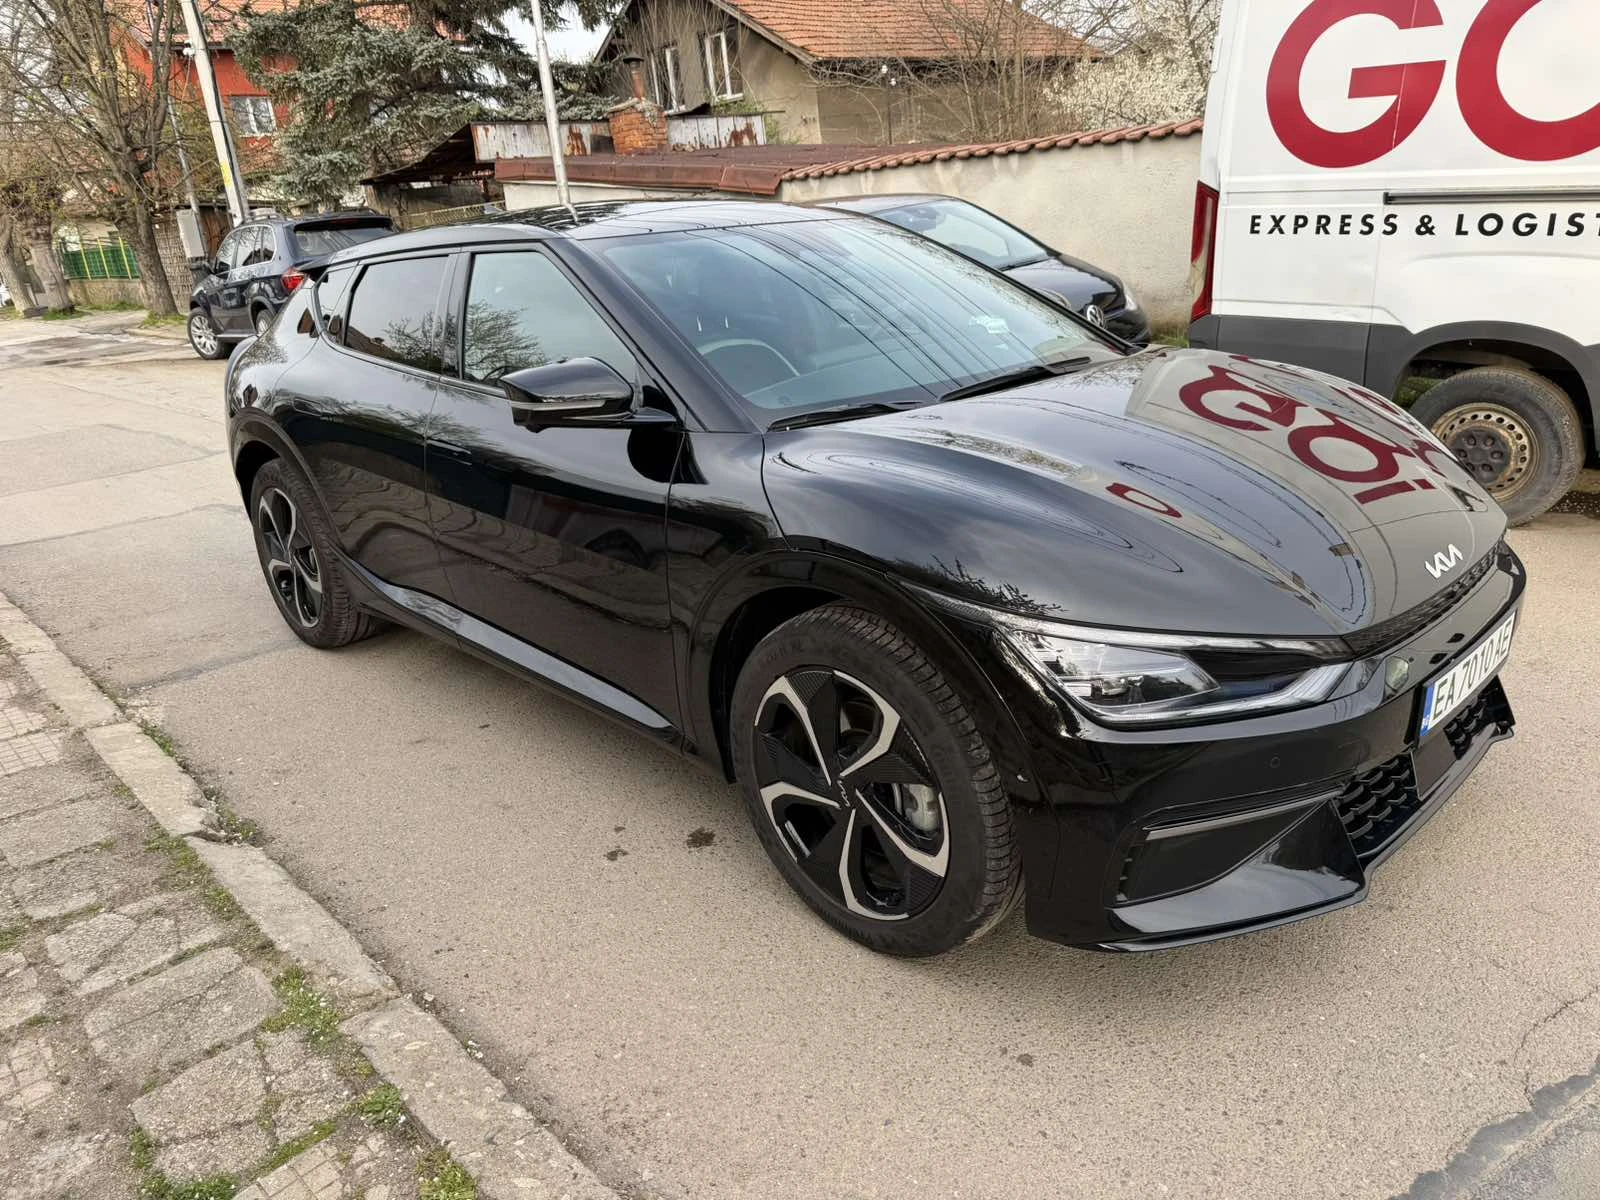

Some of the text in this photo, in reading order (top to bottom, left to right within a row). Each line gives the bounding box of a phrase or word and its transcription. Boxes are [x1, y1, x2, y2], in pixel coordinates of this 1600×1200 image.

[1250, 211, 1600, 237] EXPRESS & LOGIS
[1425, 544, 1463, 579] KIA
